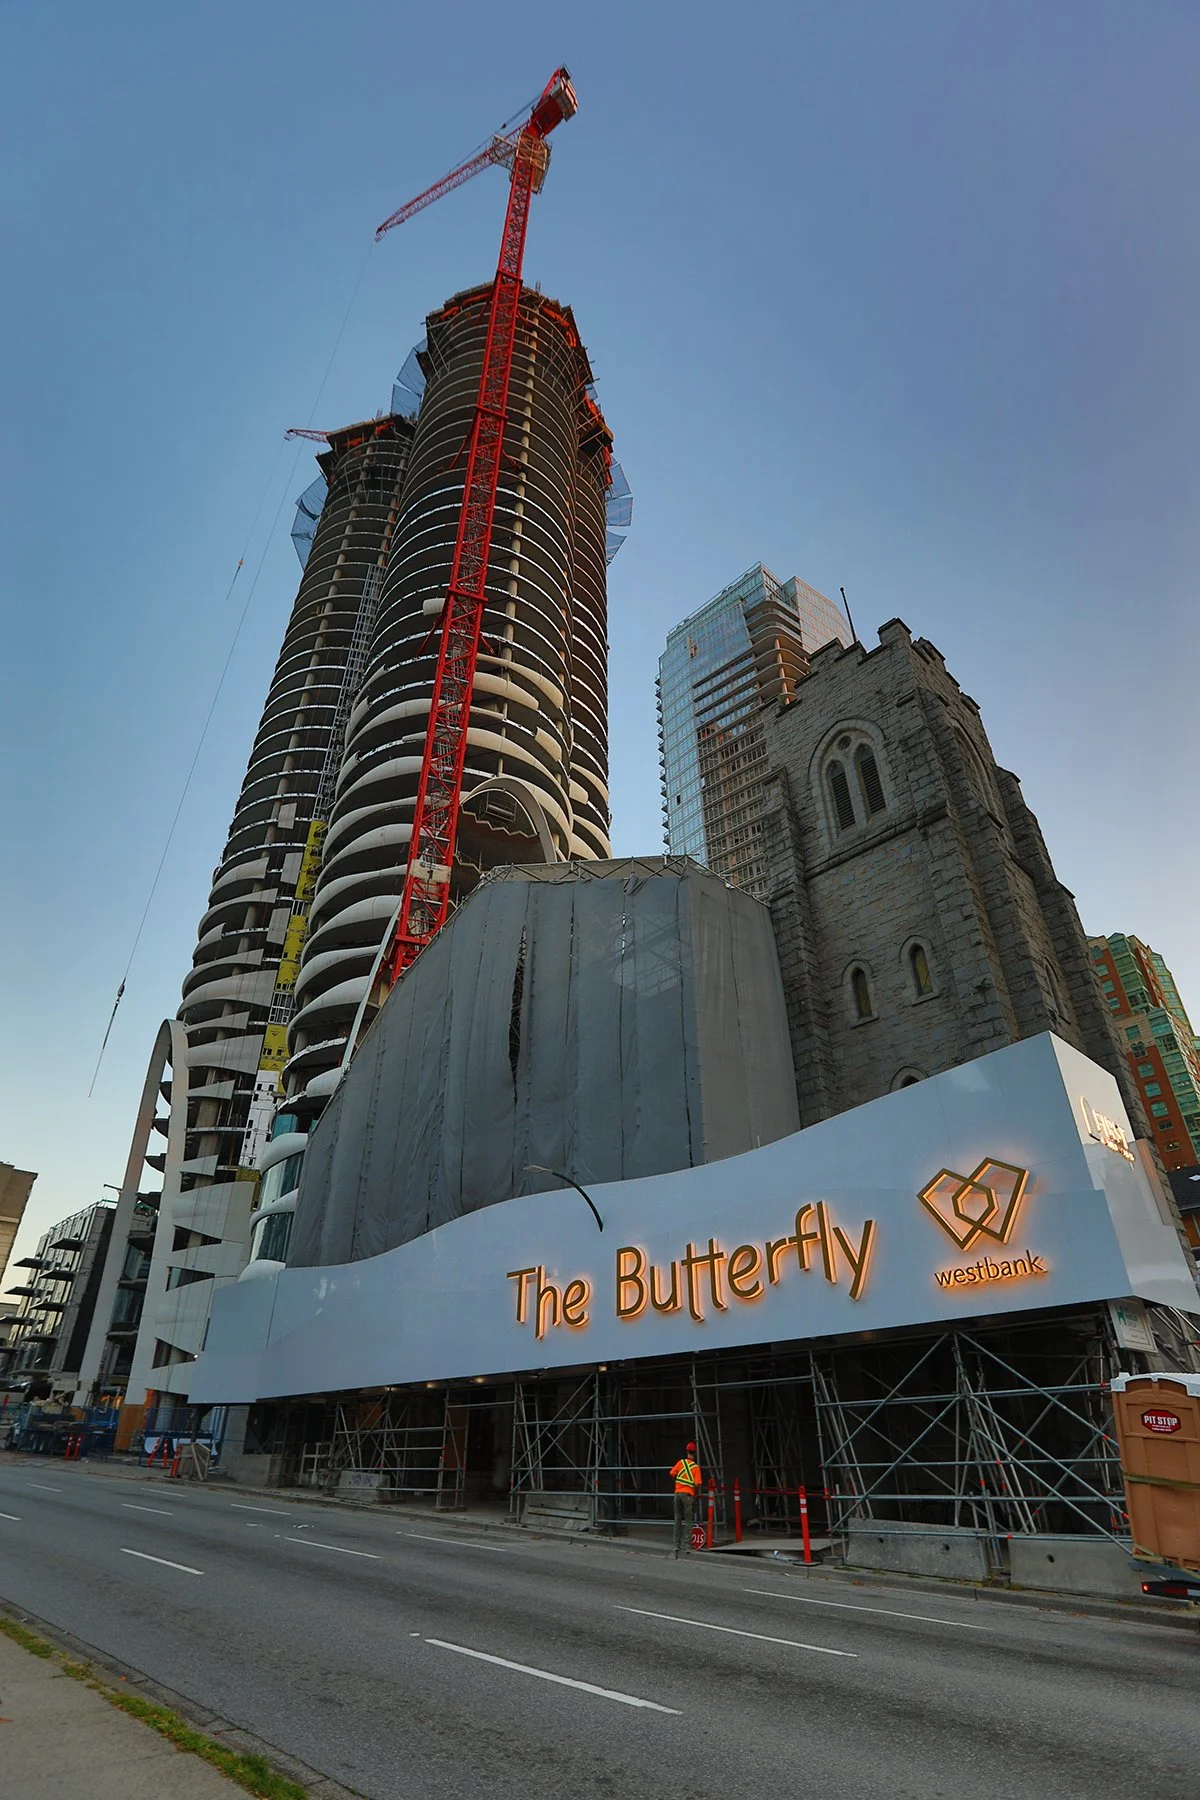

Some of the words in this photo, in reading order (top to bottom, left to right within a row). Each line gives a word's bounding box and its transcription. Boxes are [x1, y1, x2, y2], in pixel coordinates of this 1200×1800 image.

[506, 1264, 591, 1341] The
[616, 1200, 876, 1322] Butterfly
[934, 1249, 1048, 1287] westbank
[1143, 1415, 1157, 1425] PIT
[1157, 1416, 1178, 1427] STOP
[691, 1534, 704, 1543] STO
